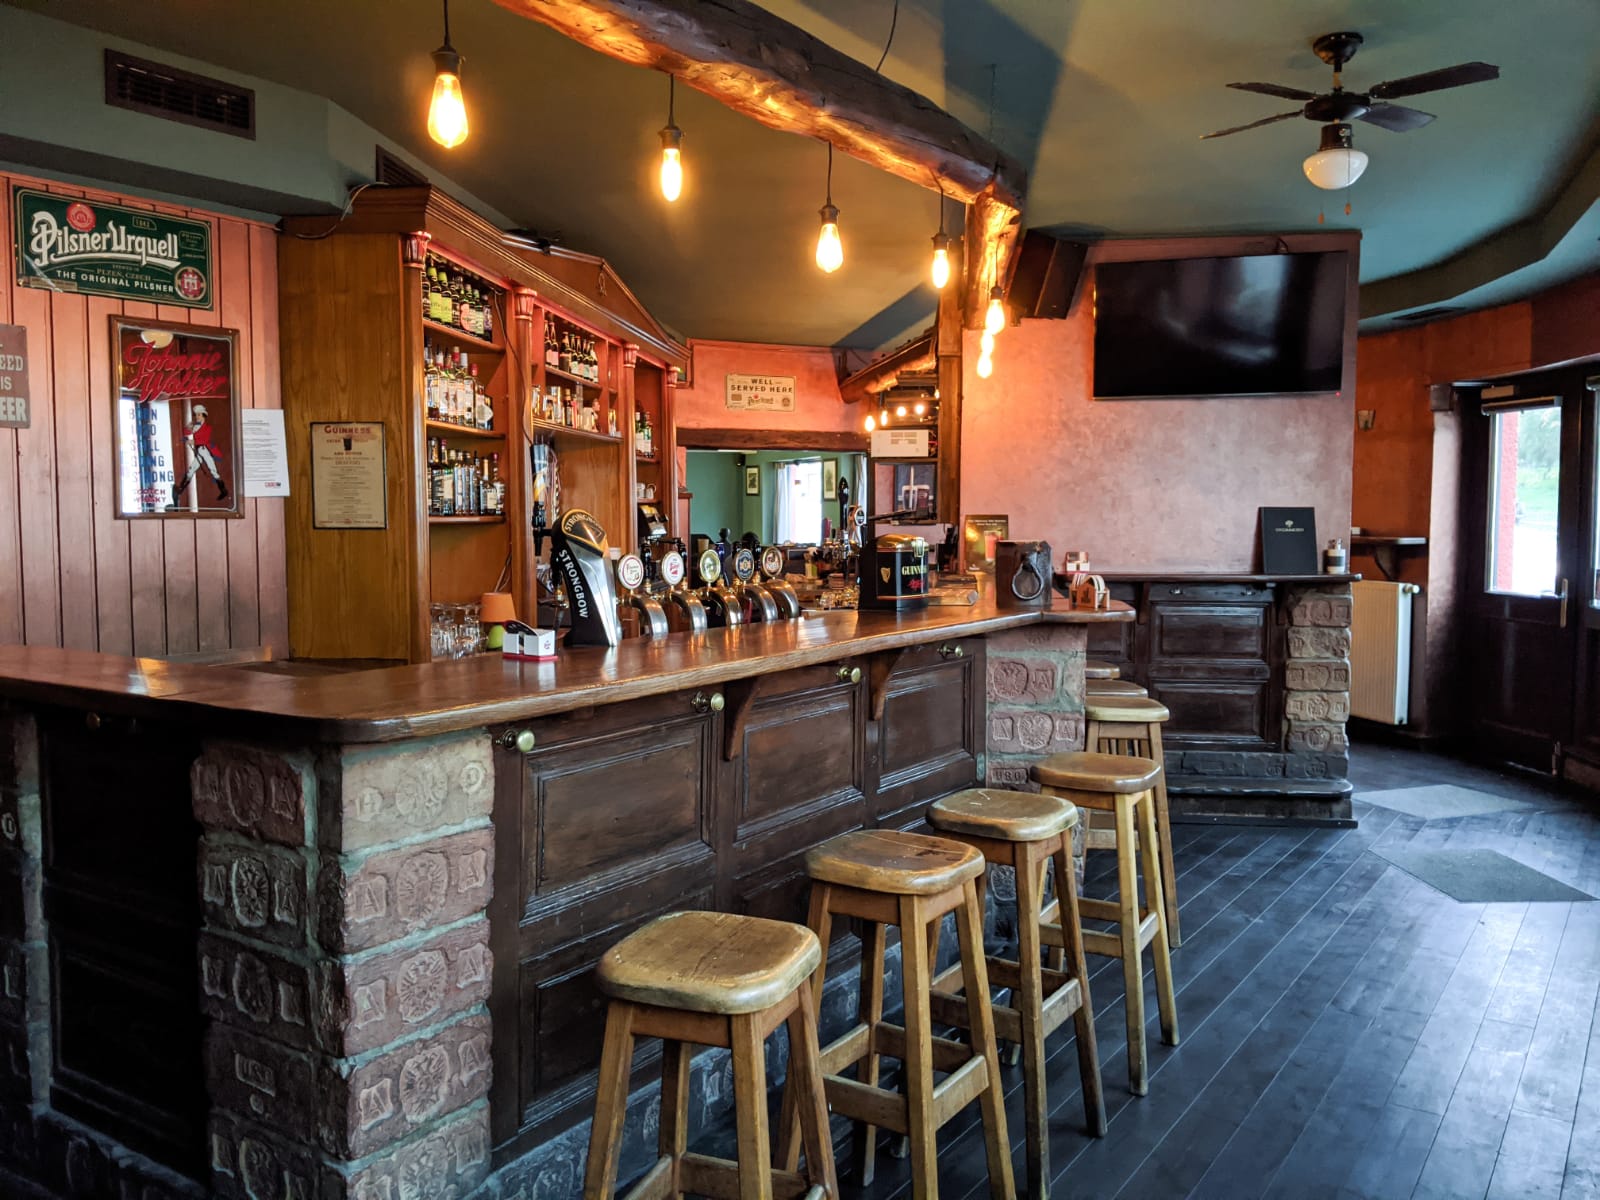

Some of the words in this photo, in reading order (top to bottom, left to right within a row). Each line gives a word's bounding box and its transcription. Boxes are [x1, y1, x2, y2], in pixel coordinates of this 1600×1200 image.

[31, 211, 111, 267] Pilsner
[108, 220, 179, 266] Urquell
[56, 270, 77, 280] THE
[80, 273, 131, 288] ORIGINAL
[134, 280, 175, 294] PILSNER
[124, 340, 224, 390] Johnnie
[139, 369, 229, 403] Walker
[730, 384, 767, 392] SERVED
[324, 425, 372, 435] GUINNESS
[559, 549, 589, 619] STRONGBOW
